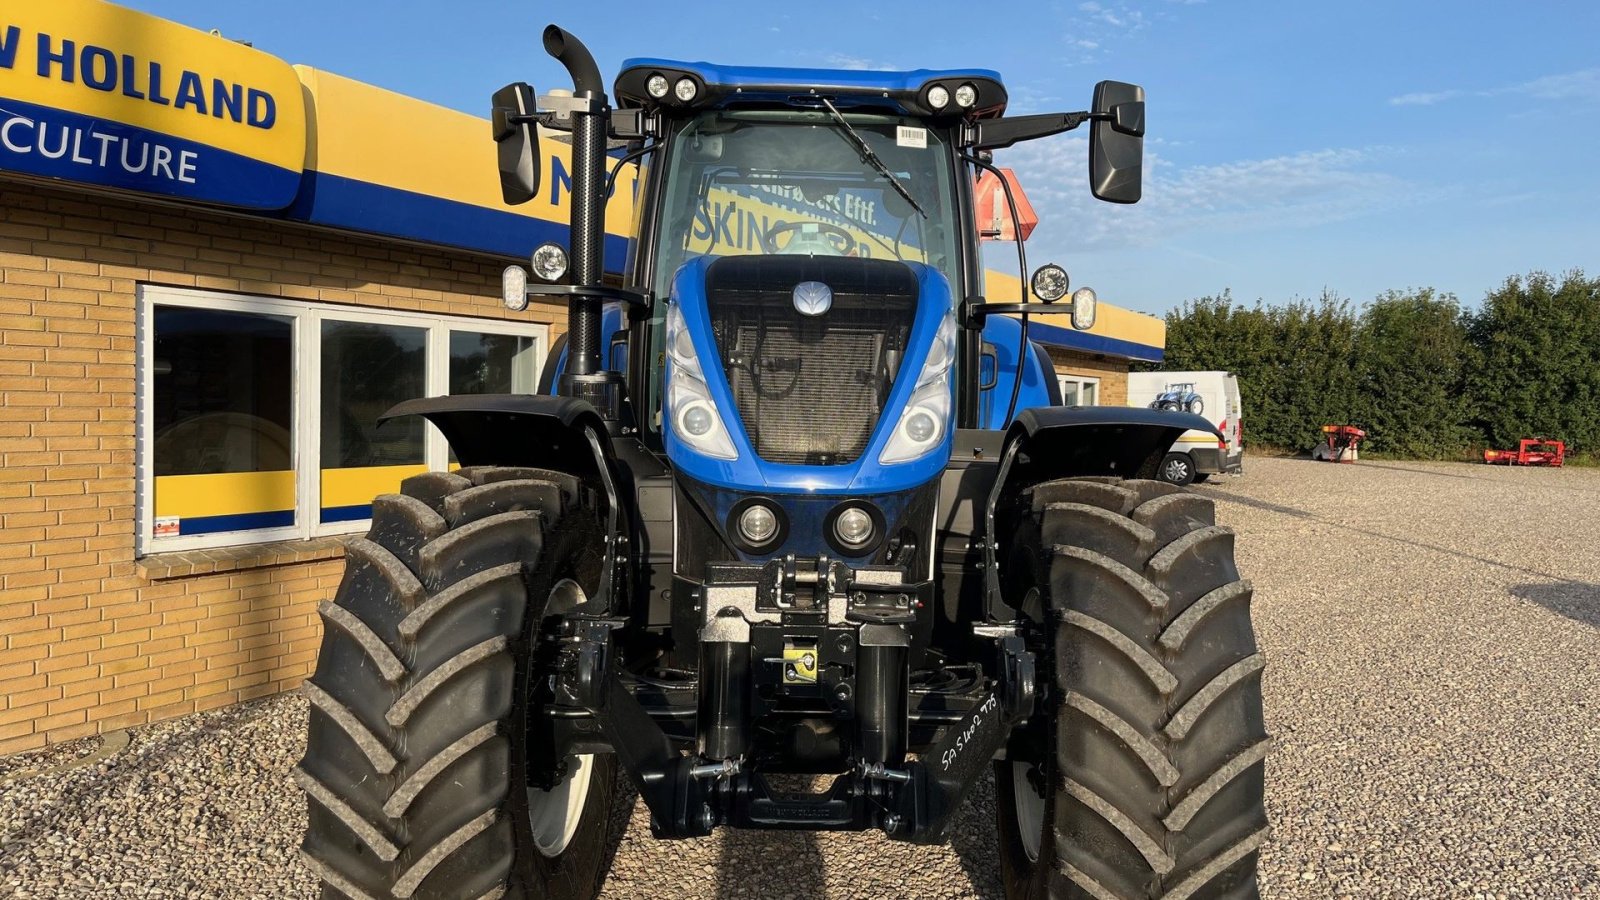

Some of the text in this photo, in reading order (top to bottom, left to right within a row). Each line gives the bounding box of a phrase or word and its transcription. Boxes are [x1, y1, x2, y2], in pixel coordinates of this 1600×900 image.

[36, 32, 277, 130] HOLLAND
[1, 117, 199, 184] CULTURE
[844, 192, 877, 226] Eftf.
